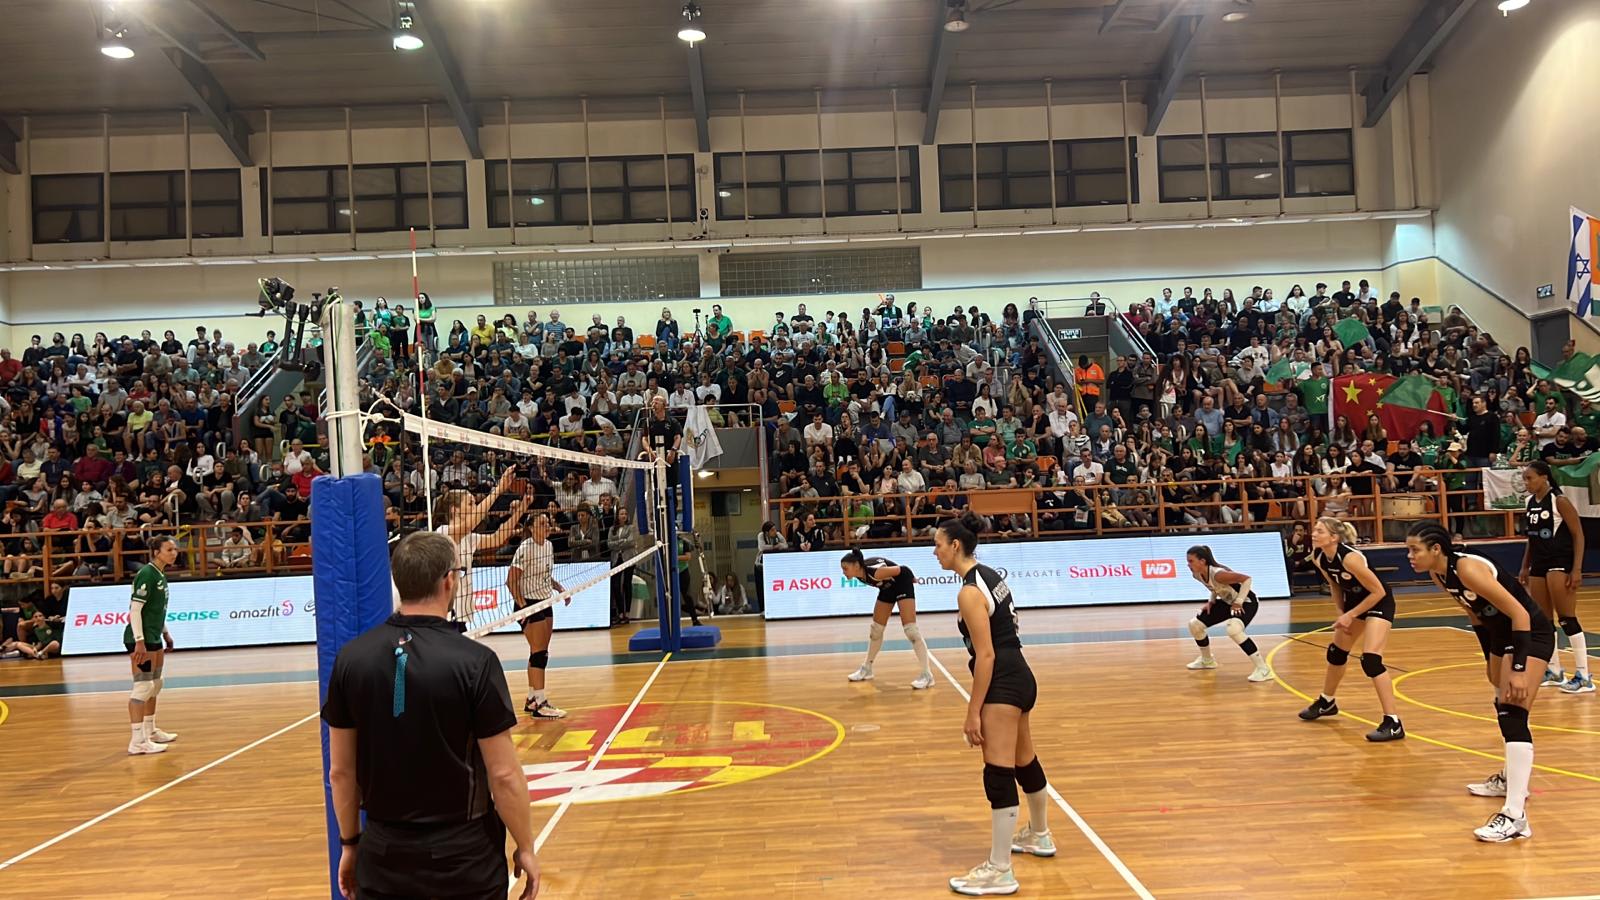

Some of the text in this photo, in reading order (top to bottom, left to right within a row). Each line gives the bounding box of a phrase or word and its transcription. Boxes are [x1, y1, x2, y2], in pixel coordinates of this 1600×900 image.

[1529, 513, 1539, 524] 19
[789, 577, 832, 591] ASKO
[1011, 569, 1062, 578] SEAGATE
[1069, 564, 1133, 579] SanDisk
[1145, 562, 1172, 576] WD
[229, 604, 280, 619] amazfit
